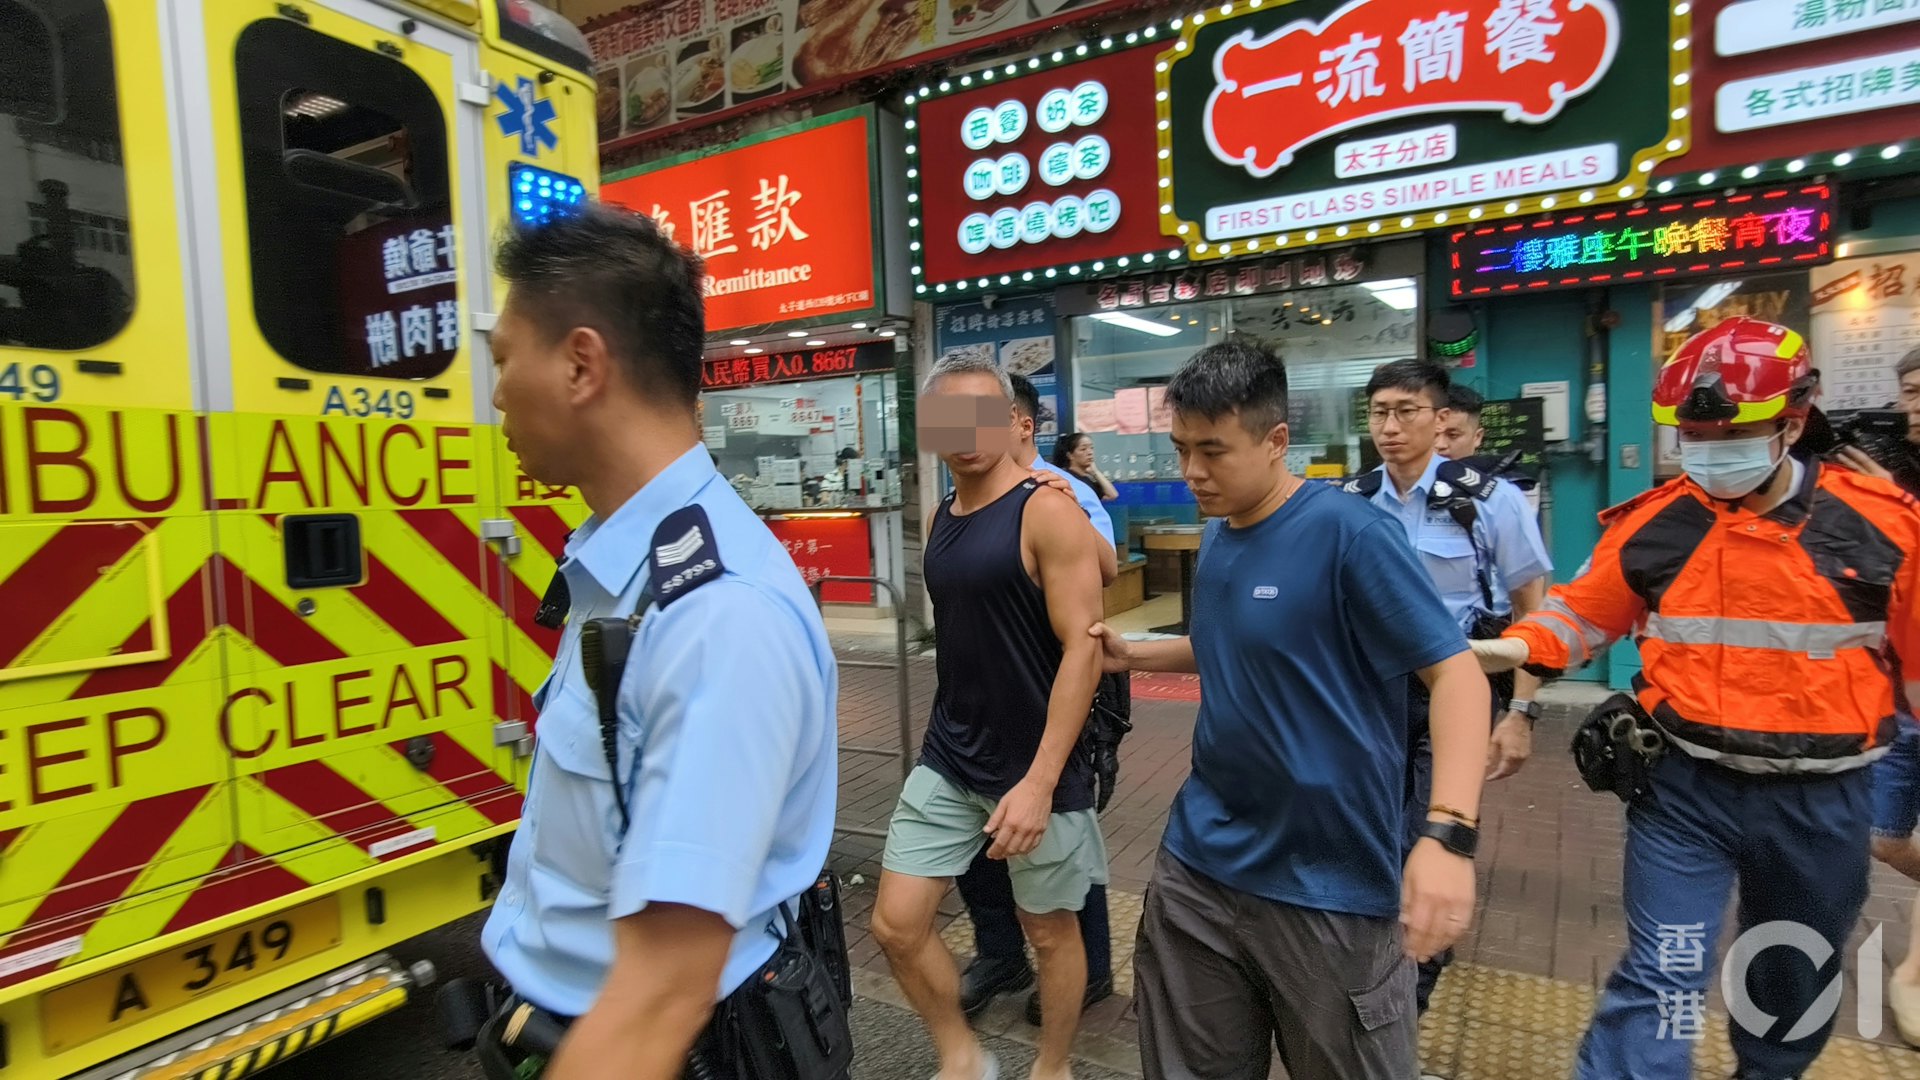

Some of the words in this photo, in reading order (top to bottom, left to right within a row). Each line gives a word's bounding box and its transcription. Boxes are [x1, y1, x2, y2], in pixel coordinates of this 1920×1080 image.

[1242, 0, 1565, 107] 一流簡餐
[1342, 132, 1449, 173] 太子分店
[1216, 205, 1282, 233] FIRST
[1291, 191, 1375, 221] CLASS
[1383, 174, 1485, 207] SIMPLE
[1494, 155, 1599, 190] MEALS
[1475, 207, 1816, 274] 二樓雅座午晚餐宵夜
[703, 263, 812, 297] Remittance
[0, 361, 61, 403] 49
[322, 385, 415, 419] A349
[0, 407, 477, 514] BULANCE
[0, 706, 168, 813] EP
[219, 654, 475, 759] CLEAR
[108, 973, 149, 1023] A
[181, 921, 294, 991] 349
